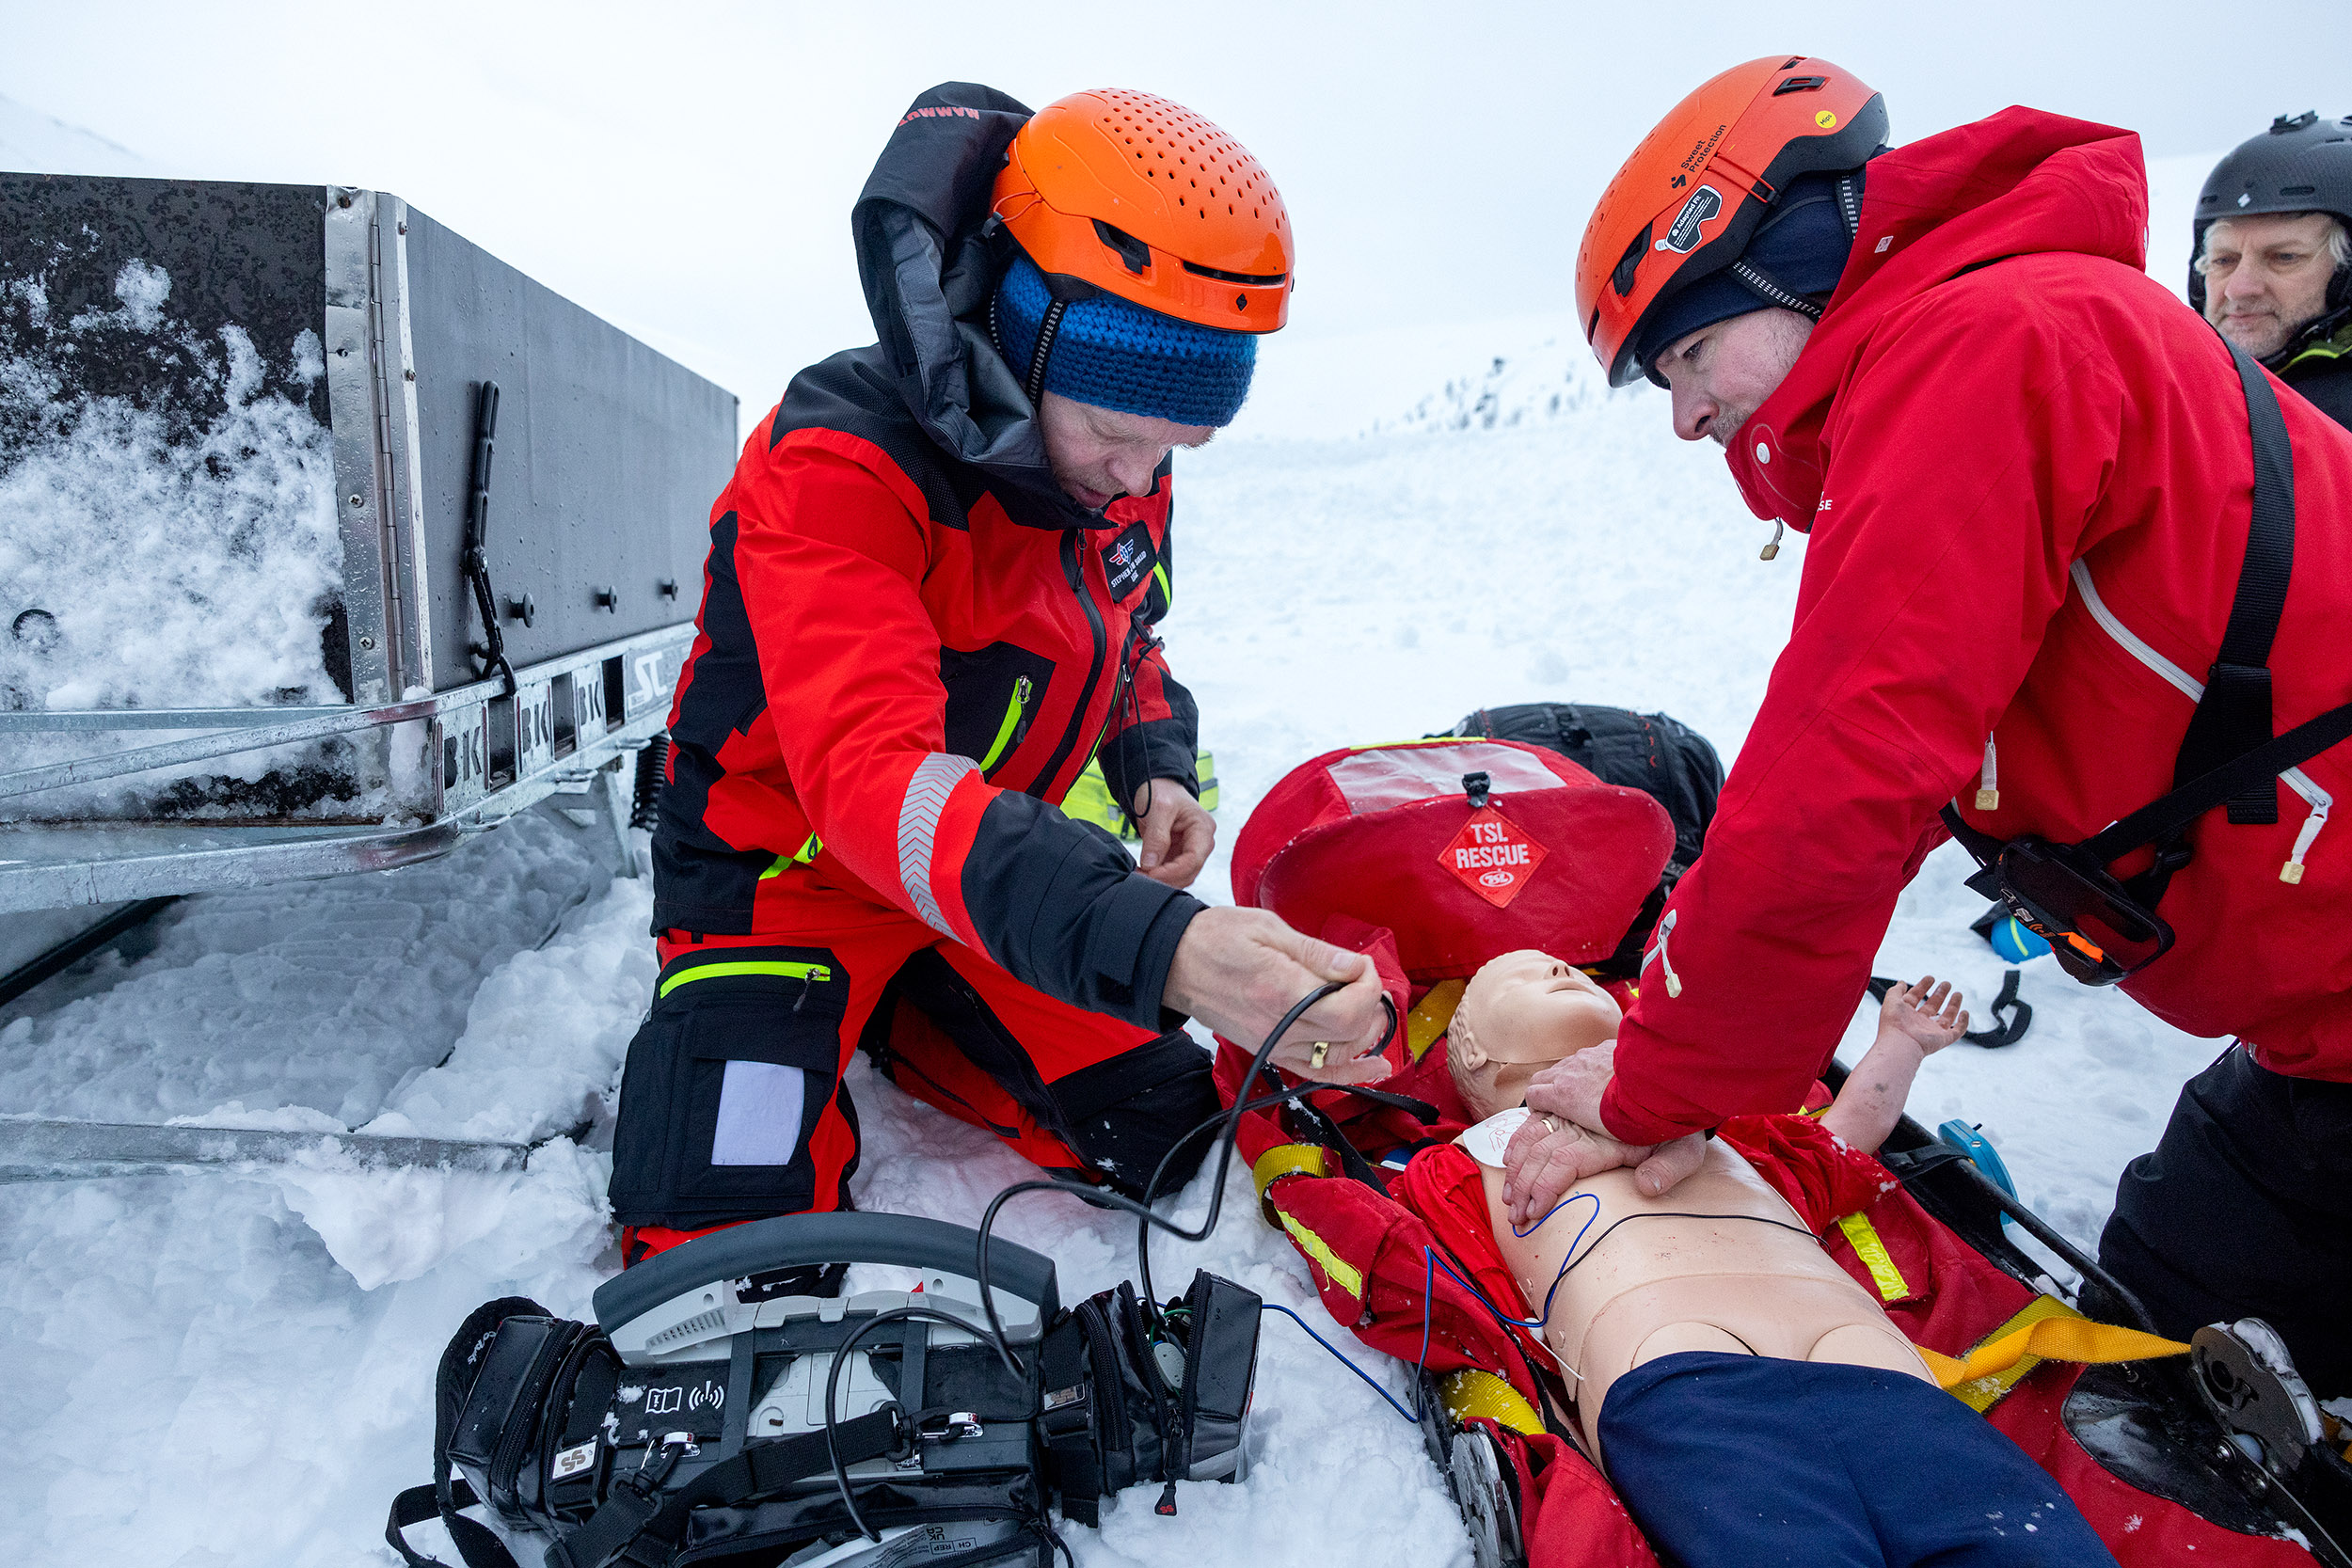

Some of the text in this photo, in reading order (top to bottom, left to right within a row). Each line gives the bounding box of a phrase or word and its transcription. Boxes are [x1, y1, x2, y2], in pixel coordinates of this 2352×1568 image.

[1680, 140, 1706, 168] Sweet
[1689, 124, 1727, 172] Protection
[1816, 499, 1833, 512] SE
[1470, 822, 1509, 844] TSL
[1455, 844, 1531, 868] RESCUE
[1485, 873, 1509, 884] TSL
